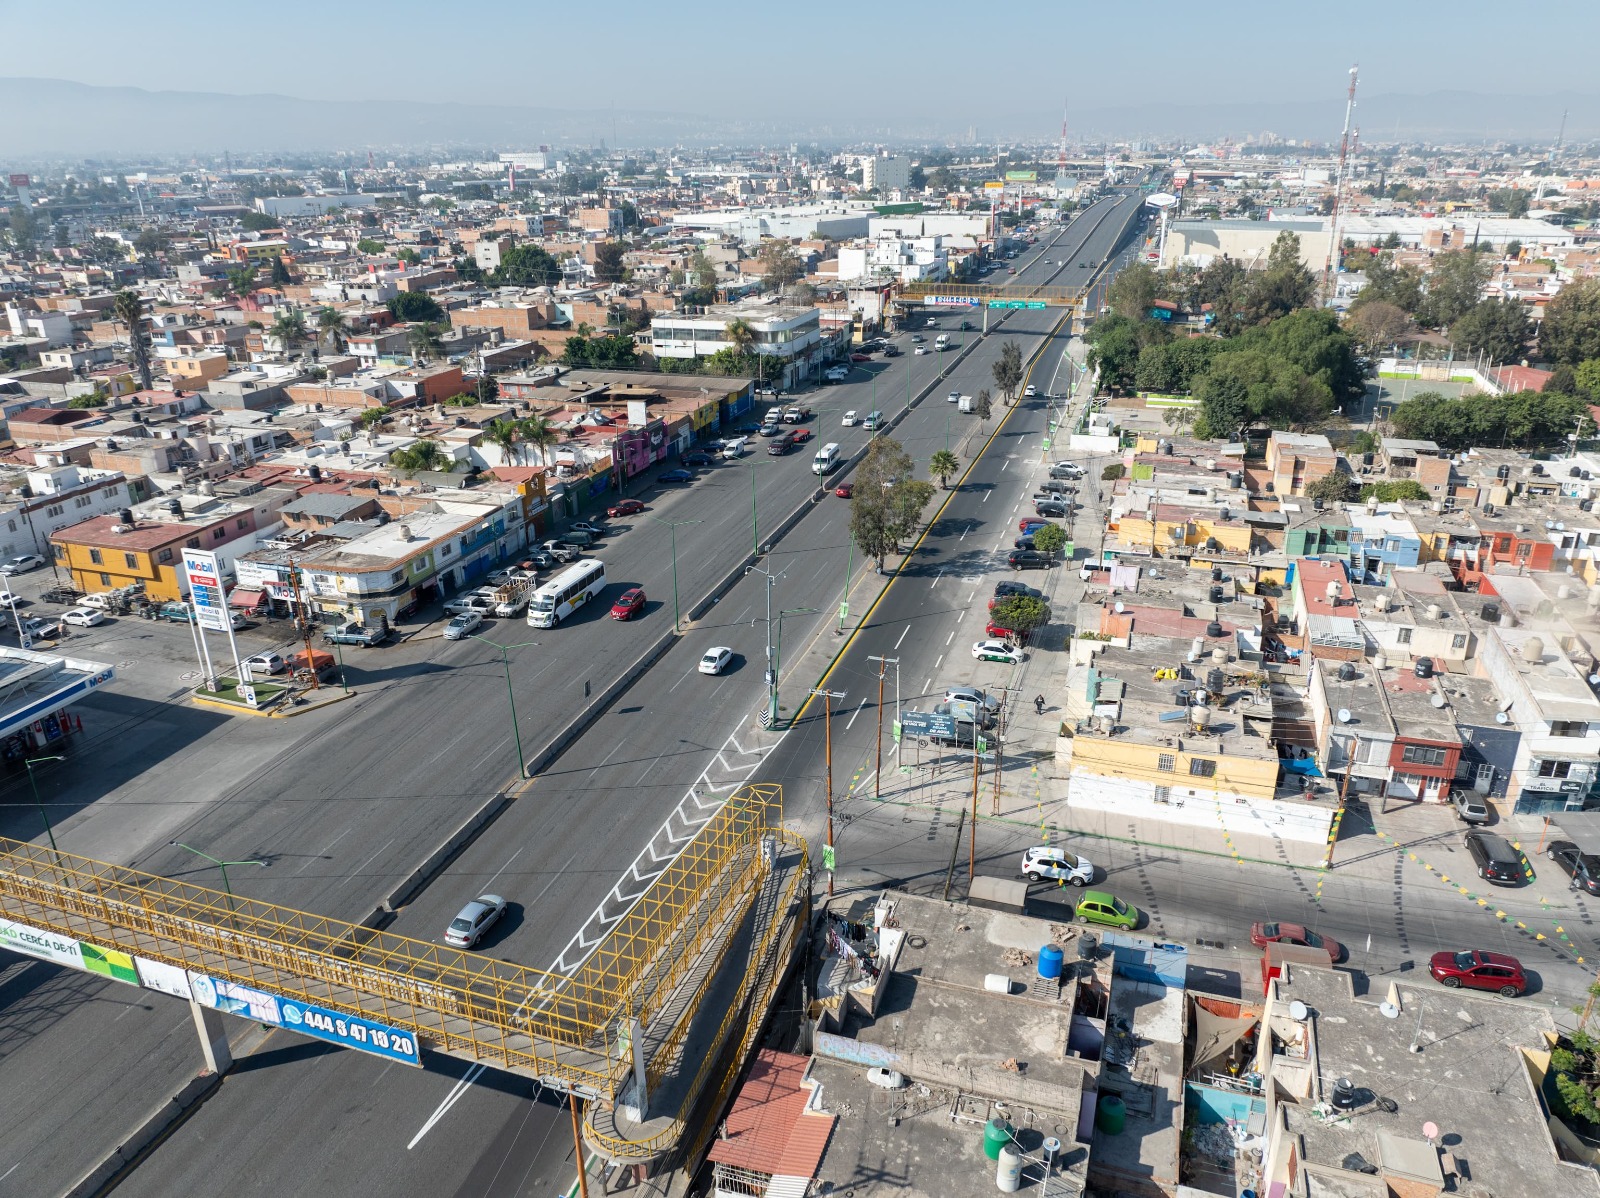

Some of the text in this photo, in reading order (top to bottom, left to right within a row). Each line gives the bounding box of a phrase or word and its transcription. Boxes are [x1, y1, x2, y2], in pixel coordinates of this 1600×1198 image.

[187, 560, 214, 572] Mobil
[90, 670, 113, 687] Mobil
[20, 932, 52, 948] CERCA
[53, 942, 66, 952] DE
[68, 946, 77, 955] TI
[304, 1011, 334, 1033] 444
[350, 1023, 367, 1042] 47
[391, 1034, 414, 1055] 20
